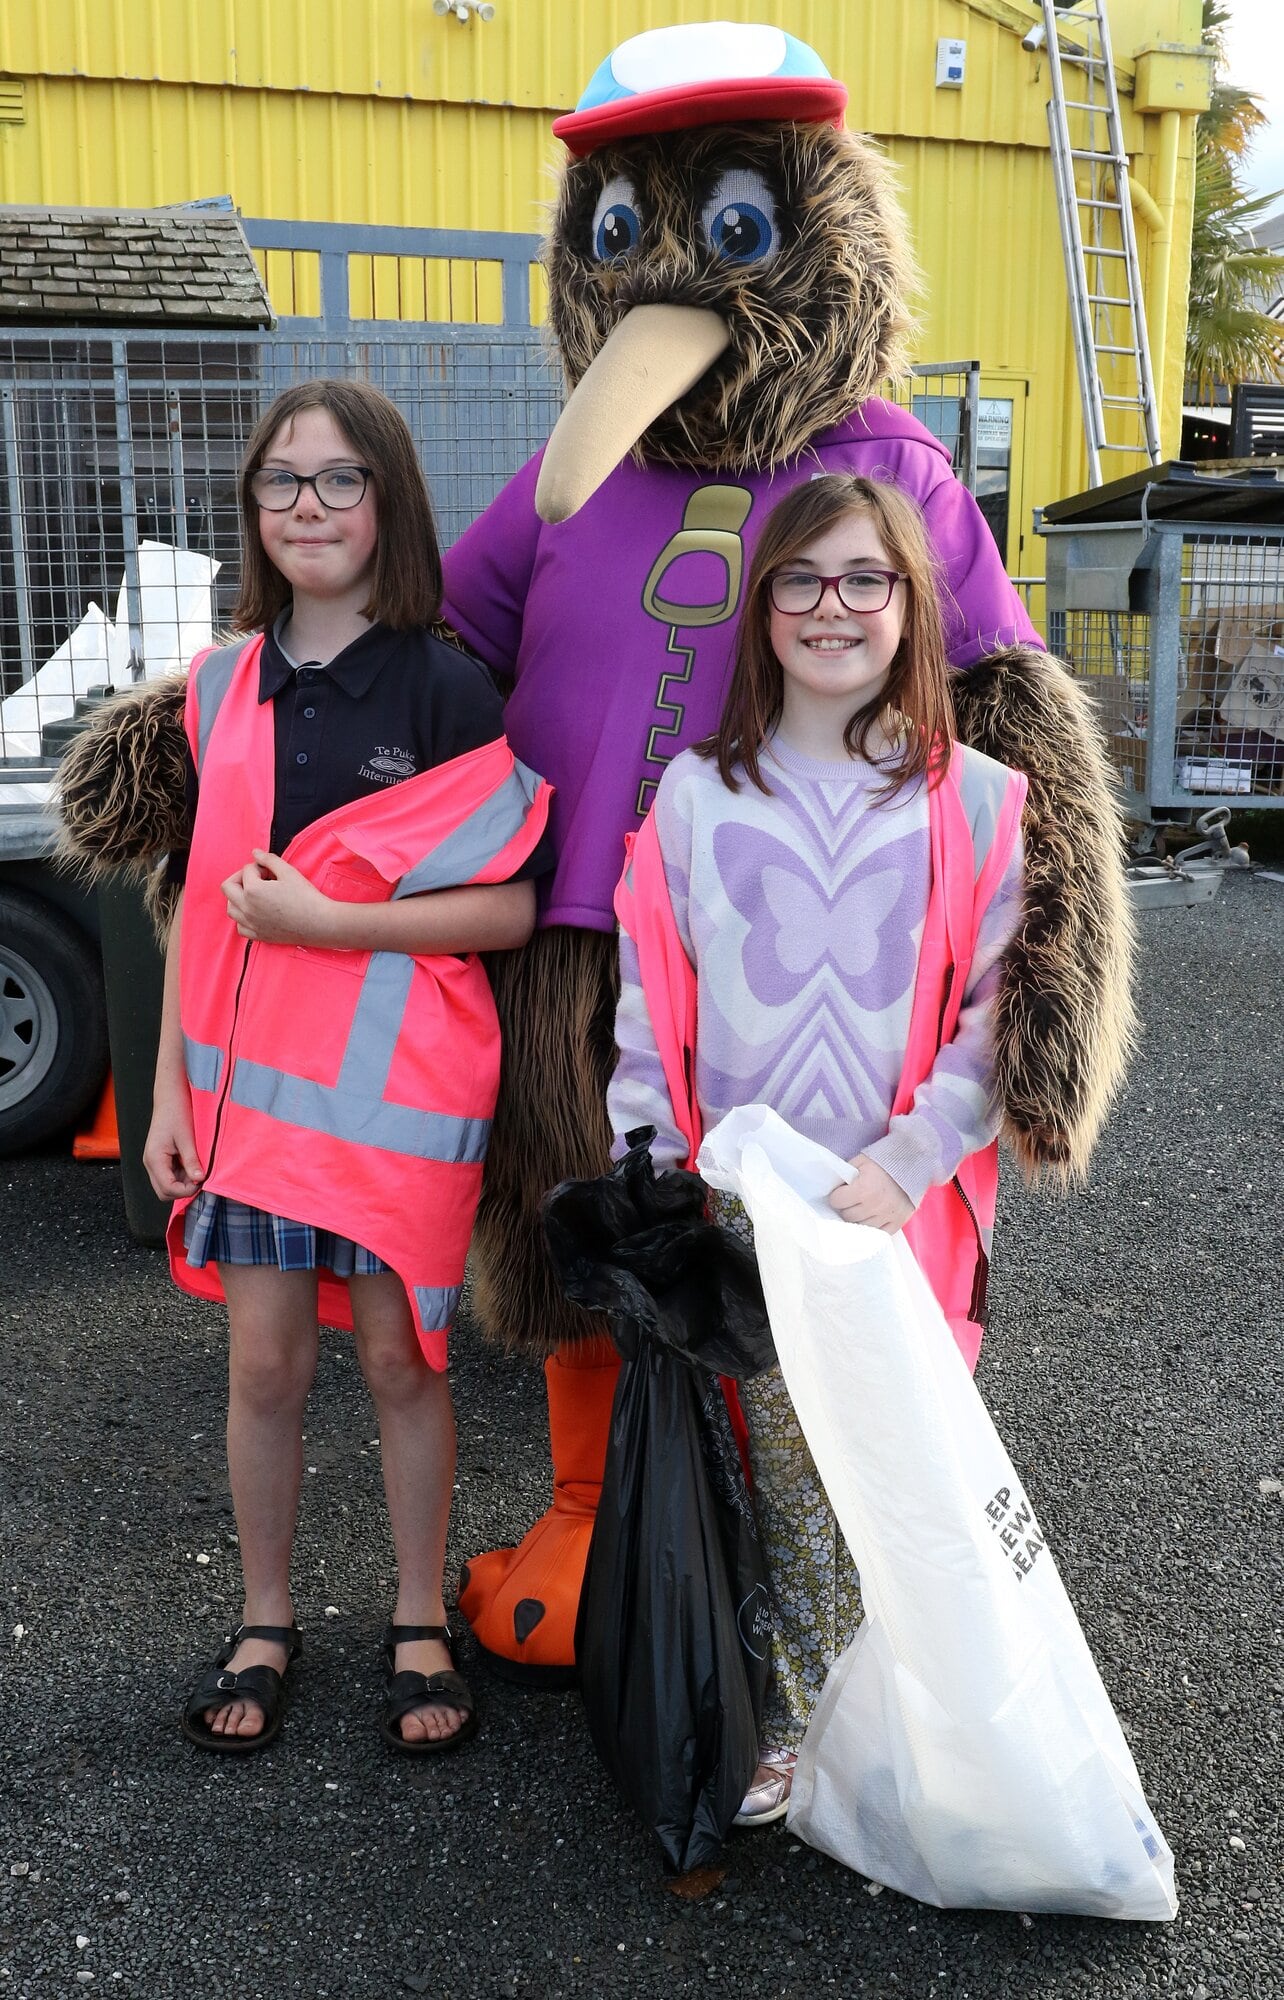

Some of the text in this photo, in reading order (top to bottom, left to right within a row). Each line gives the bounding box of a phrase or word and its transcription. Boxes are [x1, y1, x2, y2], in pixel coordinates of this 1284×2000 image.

[374, 746, 415, 761] Te Puke
[357, 765, 412, 784] Interme
[984, 1487, 1011, 1530] EP
